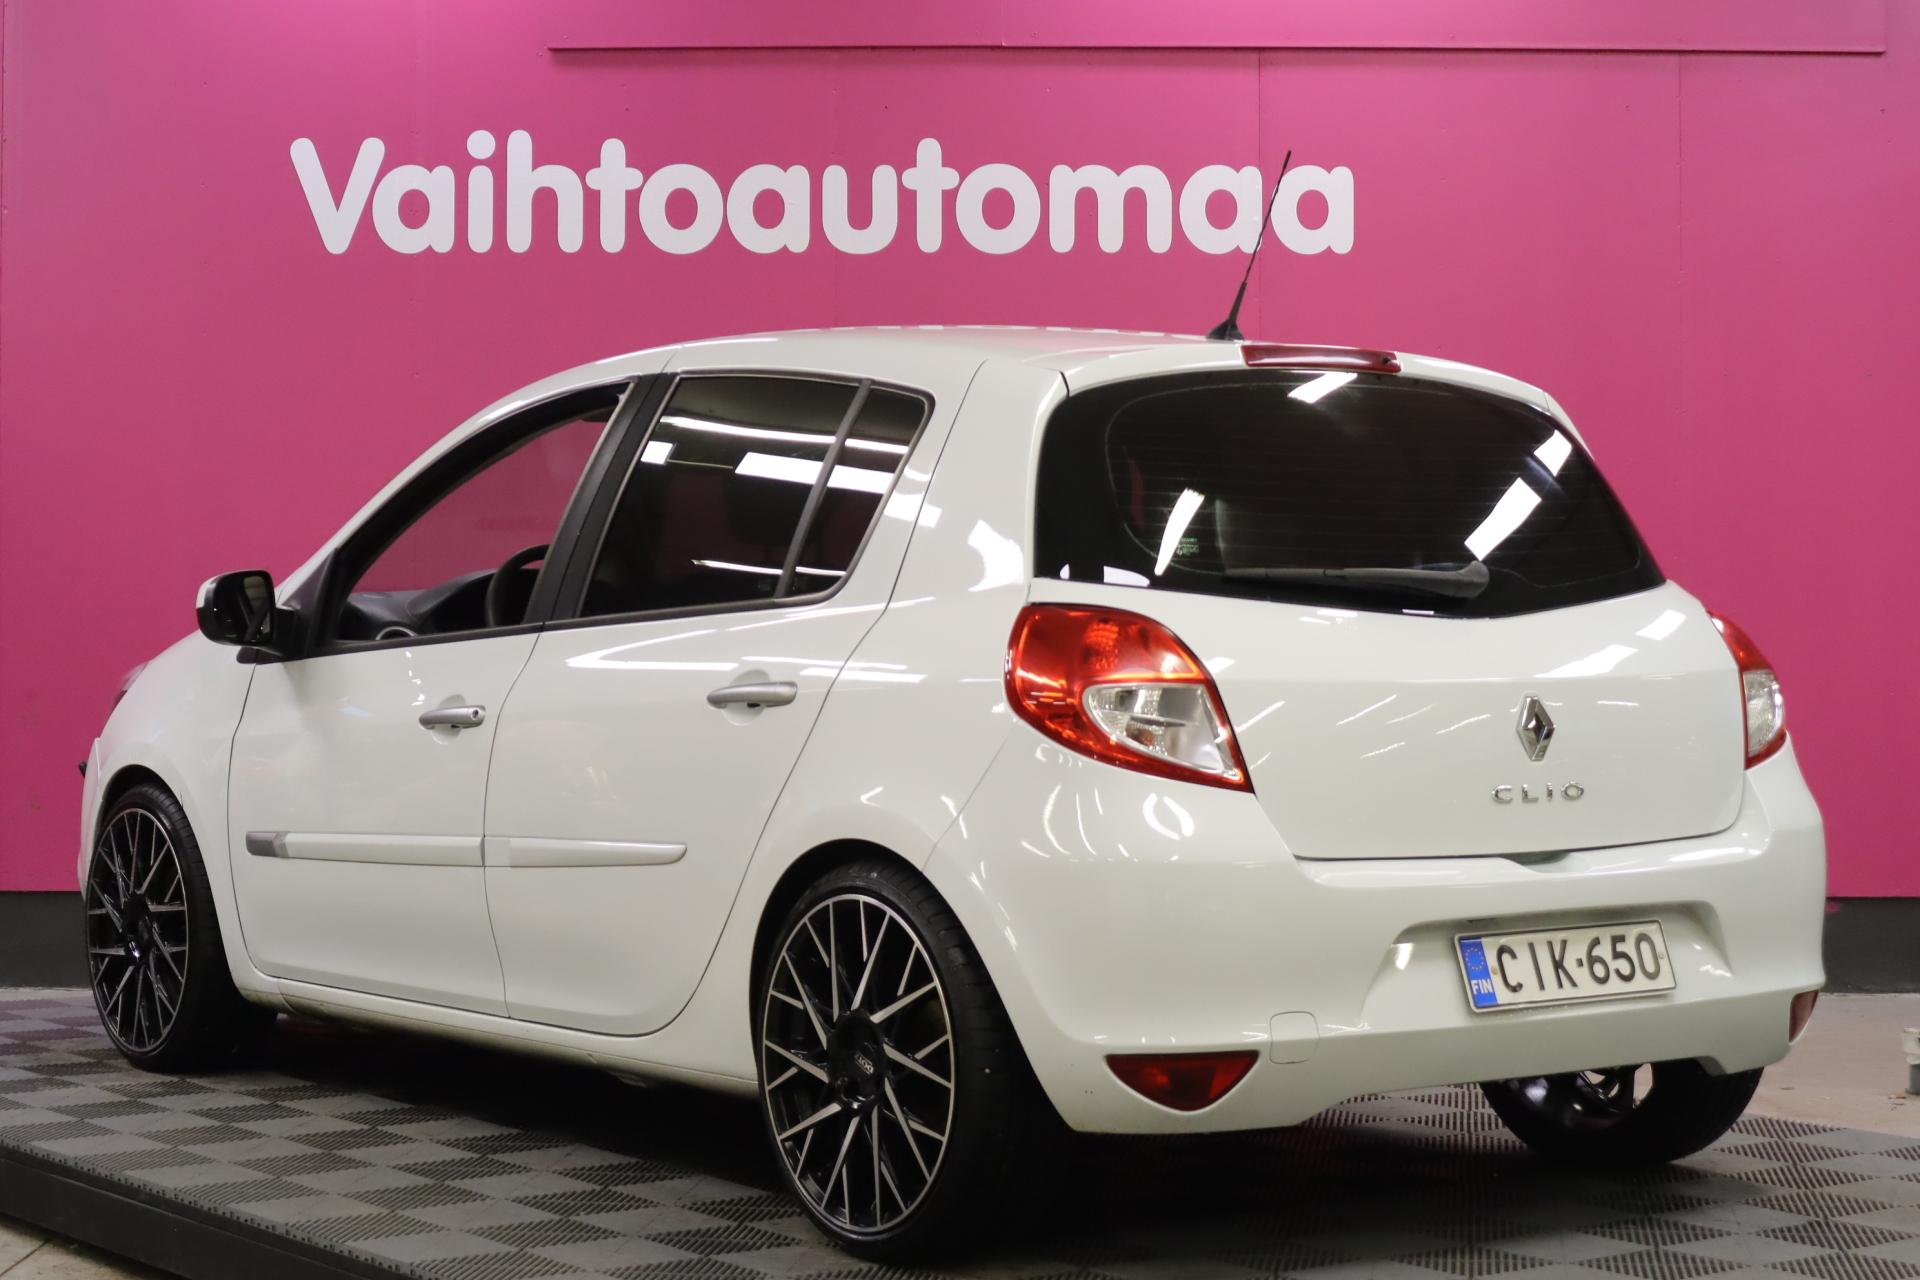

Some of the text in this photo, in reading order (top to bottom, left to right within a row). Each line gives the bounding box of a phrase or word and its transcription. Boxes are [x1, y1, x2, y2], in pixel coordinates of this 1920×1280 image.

[290, 130, 1354, 254] Vaihtoautomaa
[1492, 781, 1584, 804] CLIO
[1471, 978, 1492, 995] FIN
